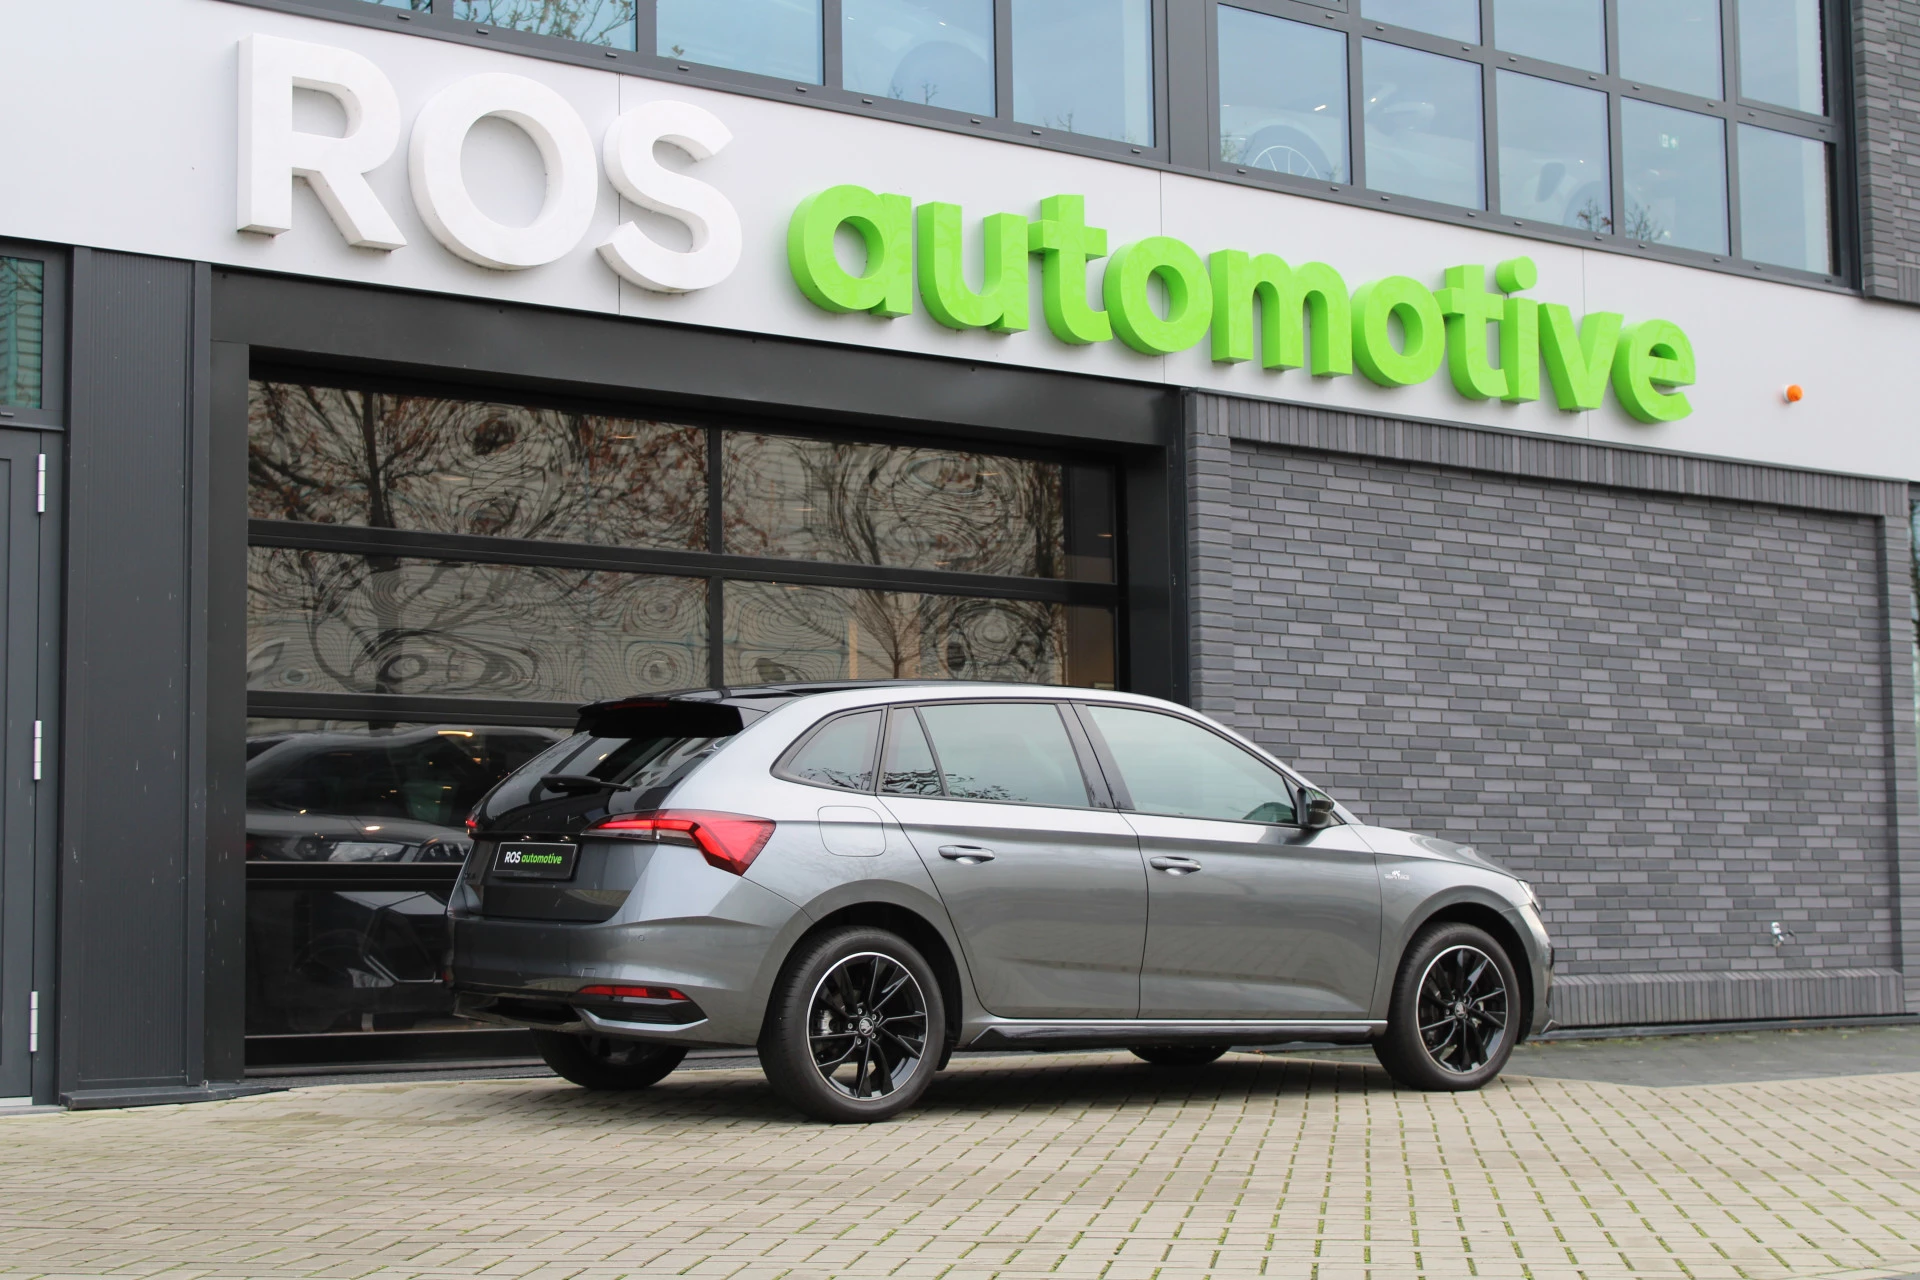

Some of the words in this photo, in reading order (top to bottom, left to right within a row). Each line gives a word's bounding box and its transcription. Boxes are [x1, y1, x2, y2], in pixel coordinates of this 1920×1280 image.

[237, 33, 742, 293] ROS
[787, 184, 1696, 424] automotive
[504, 851, 521, 864] ROS
[521, 853, 563, 864] automotive
